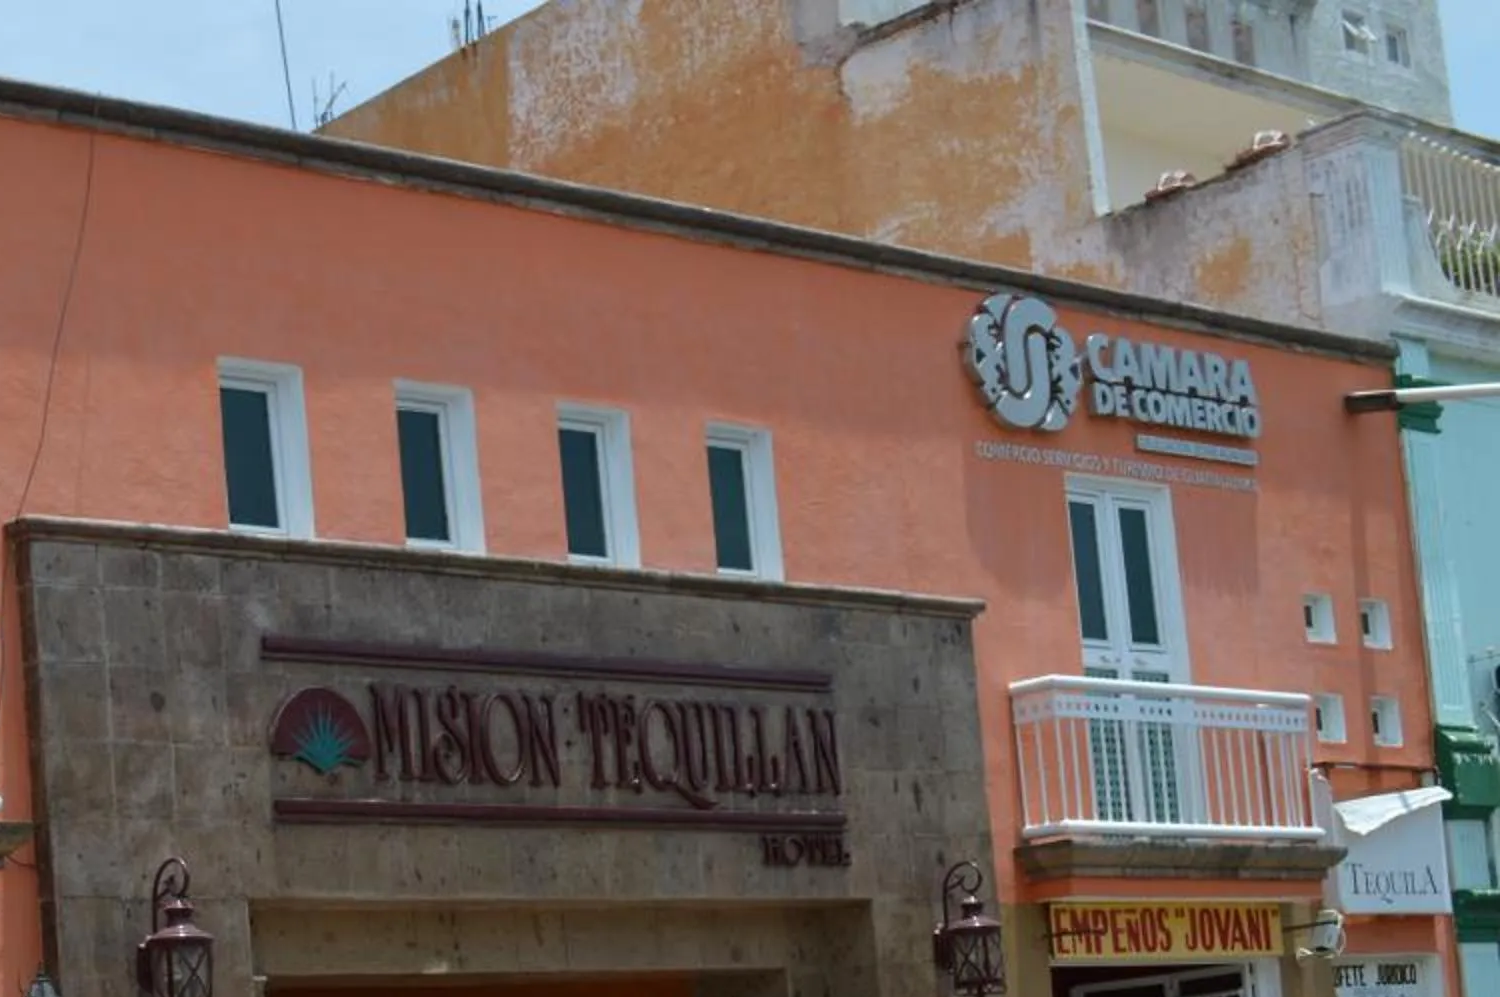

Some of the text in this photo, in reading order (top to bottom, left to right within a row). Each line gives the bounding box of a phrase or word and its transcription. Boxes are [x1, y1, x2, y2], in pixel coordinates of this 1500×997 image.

[1086, 333, 1257, 406] CAMARA
[1092, 384, 1260, 439] DE COMERCIO
[368, 682, 842, 811] MISION TEQUILLAN
[761, 834, 852, 868] HOTEL
[1345, 862, 1443, 904] TEQUILA
[1053, 907, 1173, 955] EMPEÑOS
